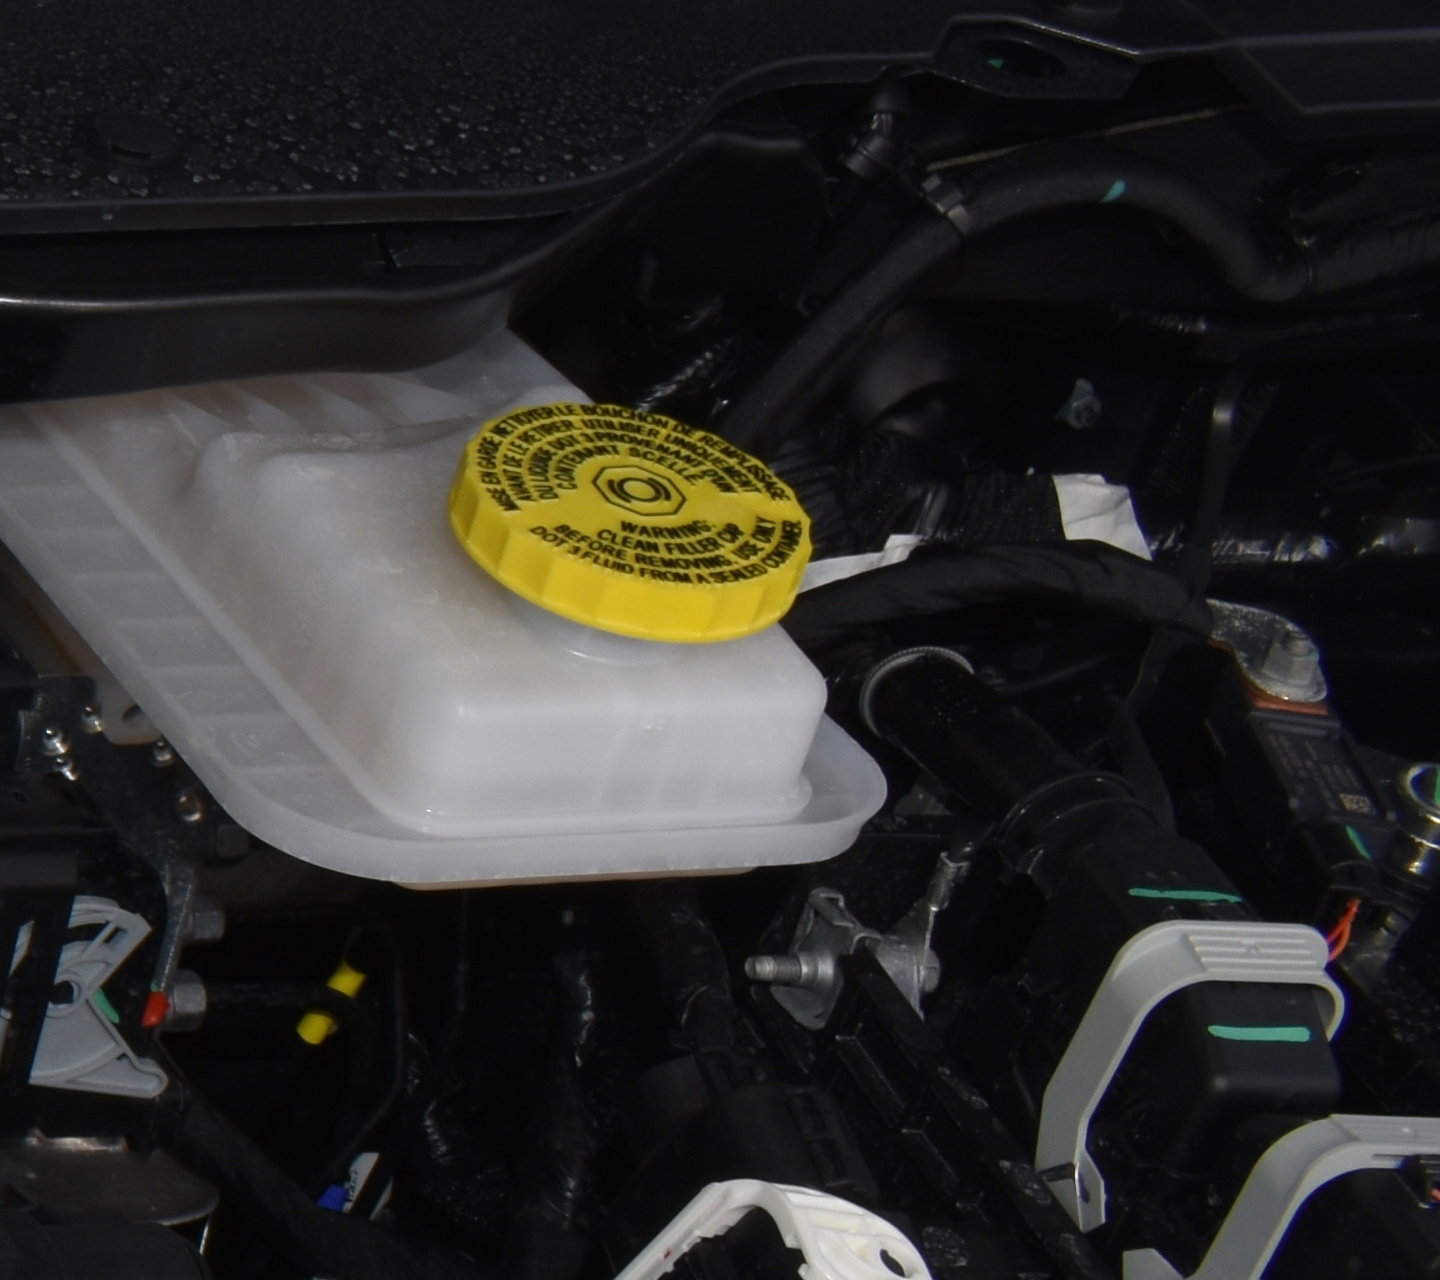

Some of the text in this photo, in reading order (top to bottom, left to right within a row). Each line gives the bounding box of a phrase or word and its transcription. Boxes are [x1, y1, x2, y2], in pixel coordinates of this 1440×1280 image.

[490, 405, 555, 439] NETTOYER
[554, 404, 577, 417] LE
[580, 404, 669, 429] BOUCHON
[547, 434, 582, 451] DOT
[581, 418, 661, 439] UTILISER
[673, 423, 696, 438] DE
[502, 454, 523, 469] DE
[507, 440, 531, 456] LE
[594, 431, 705, 468] PROVENANT
[527, 446, 559, 483] LIQUIDE
[553, 444, 621, 491] CONTENANT
[664, 433, 762, 494] UNIQUEMENT
[698, 434, 791, 501] REMPLISSAGE
[480, 471, 501, 486] EN
[503, 468, 538, 502] AVANT
[535, 485, 561, 500] DU
[553, 524, 629, 561] BEFORE
[731, 540, 765, 561] USE
[751, 515, 776, 544] ONLY
[597, 522, 744, 556] CLEAN FILLER CAP
[621, 519, 715, 539] WARNING:
[528, 525, 569, 547] DOT
[581, 550, 635, 575] FLUID
[639, 567, 693, 584] FROM
[709, 562, 769, 584] SEALED
